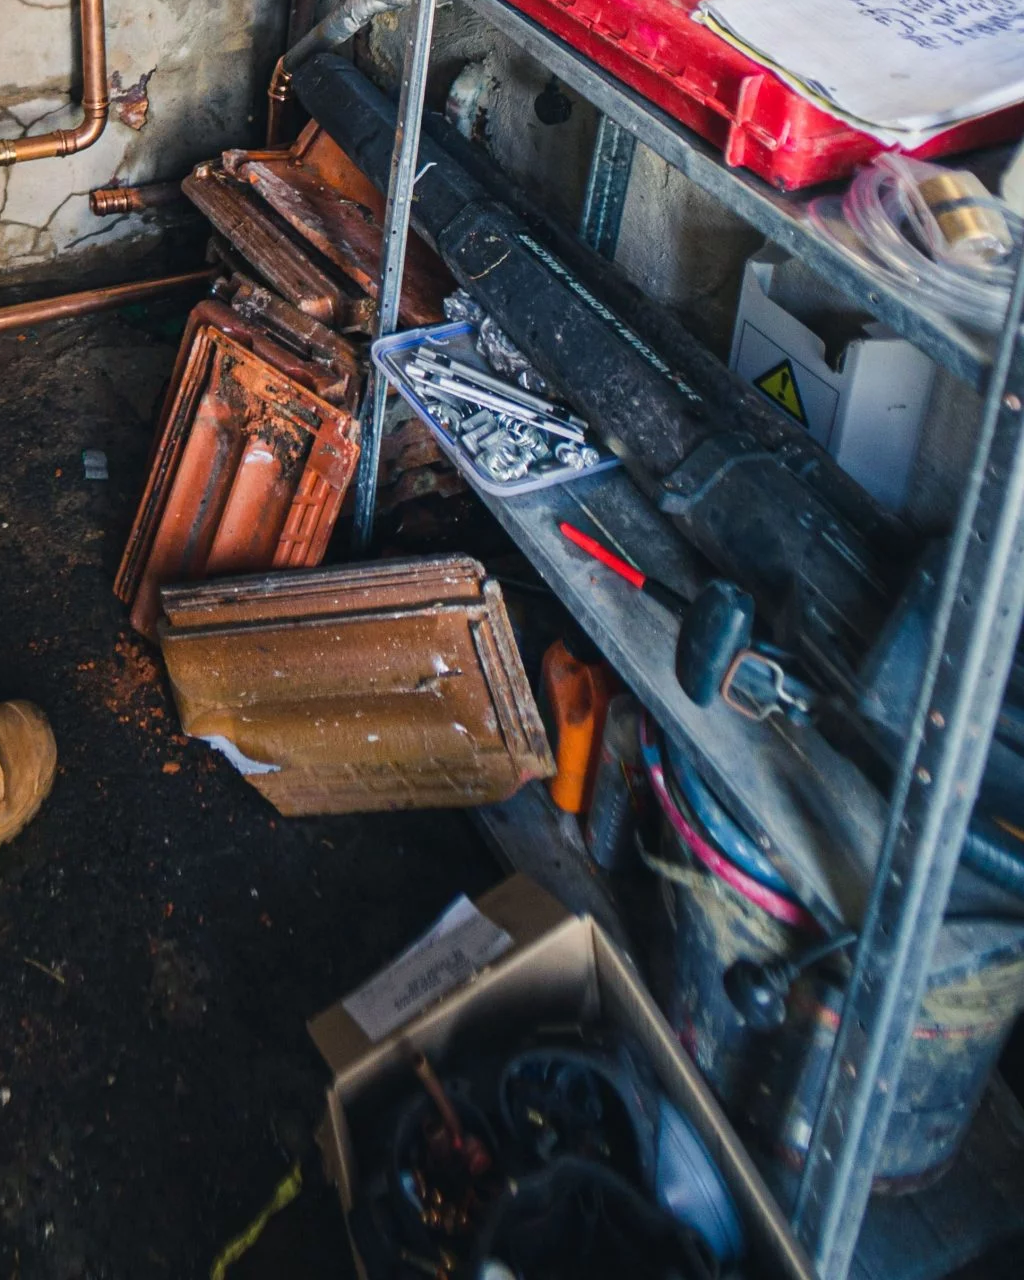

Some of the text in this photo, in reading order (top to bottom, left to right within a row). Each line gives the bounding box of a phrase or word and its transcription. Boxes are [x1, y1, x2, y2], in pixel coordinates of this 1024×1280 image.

[519, 234, 568, 276] MULCHER
[569, 282, 616, 321] BLOWER
[619, 327, 670, 373] VACUUM
